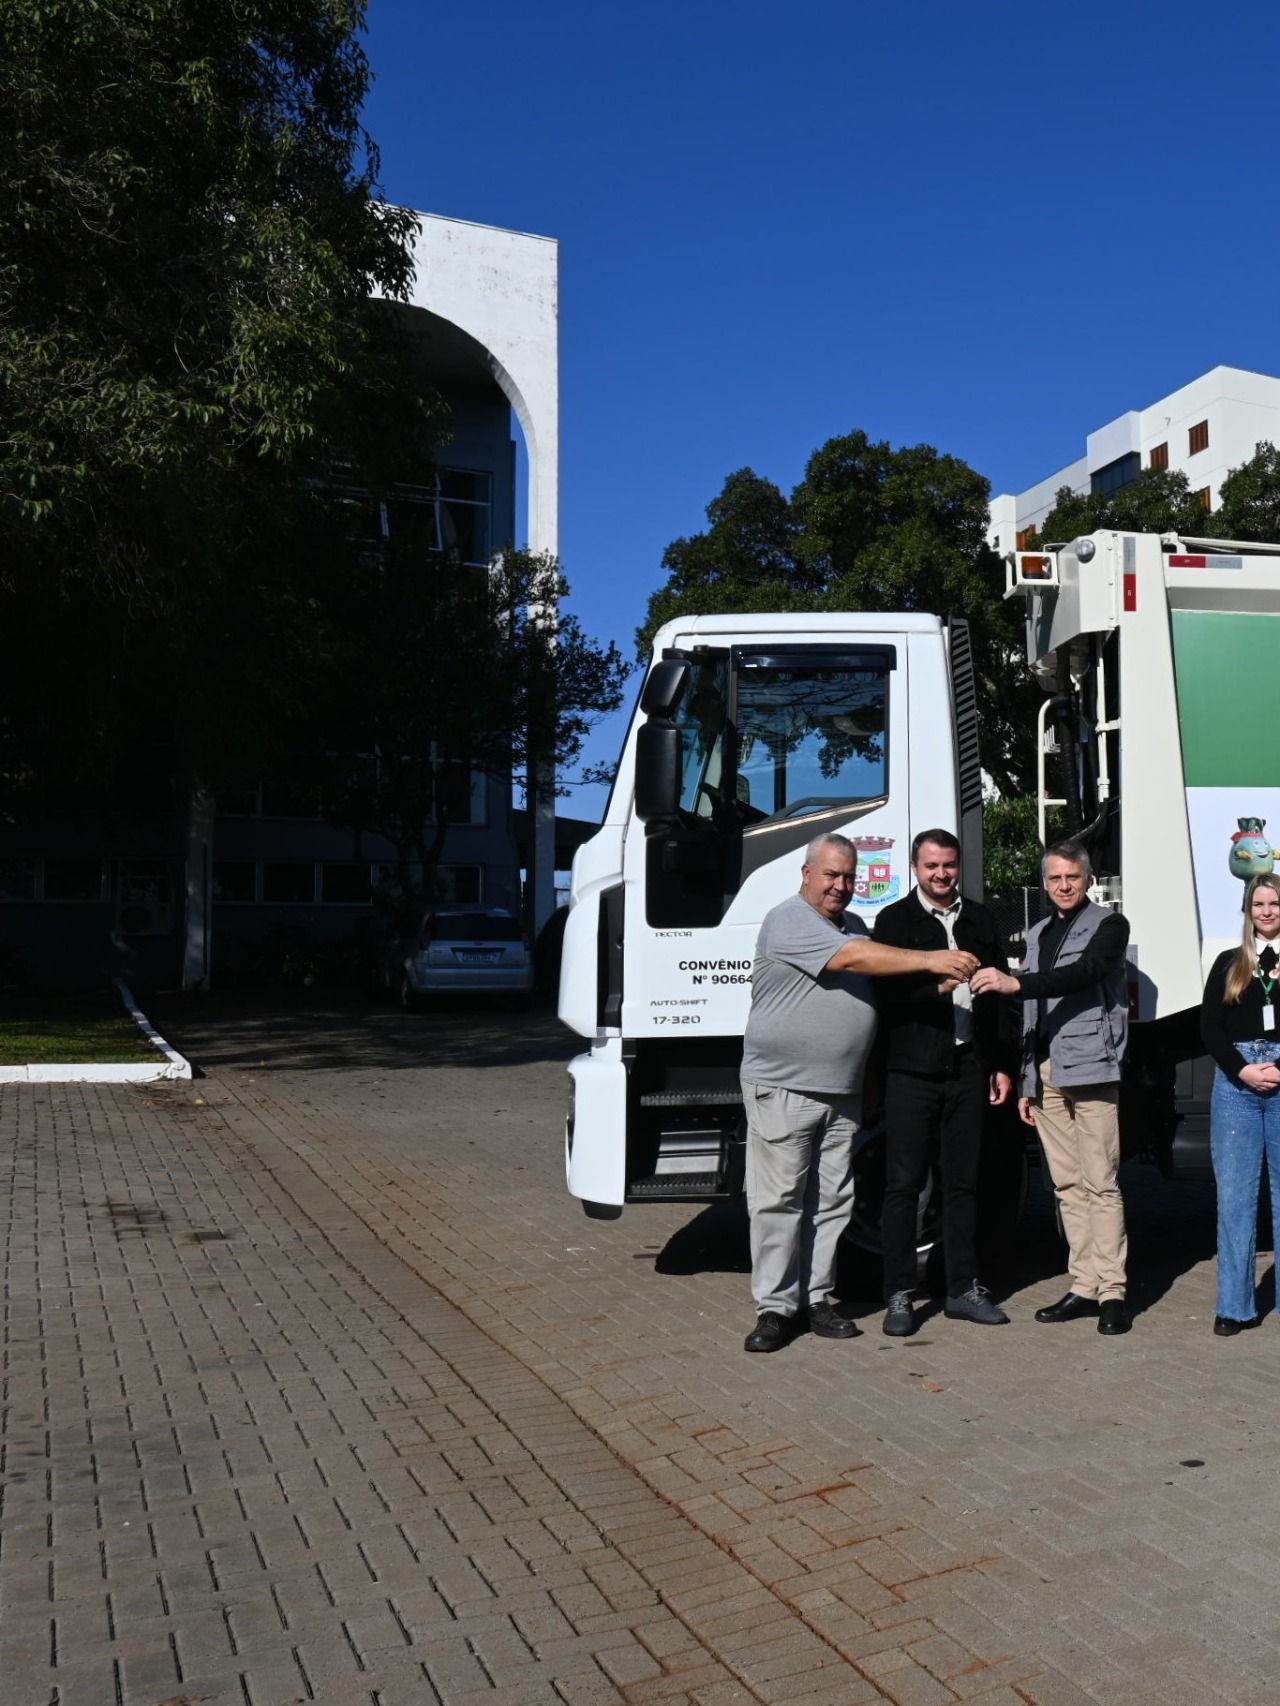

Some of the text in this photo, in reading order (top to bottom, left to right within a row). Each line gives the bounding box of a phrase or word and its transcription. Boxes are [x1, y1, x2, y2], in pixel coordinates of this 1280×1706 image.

[678, 958, 752, 971] CONVÊNIO
[650, 999, 708, 1007] AUTO-SHIFT
[652, 1015, 701, 1025] 17-320
